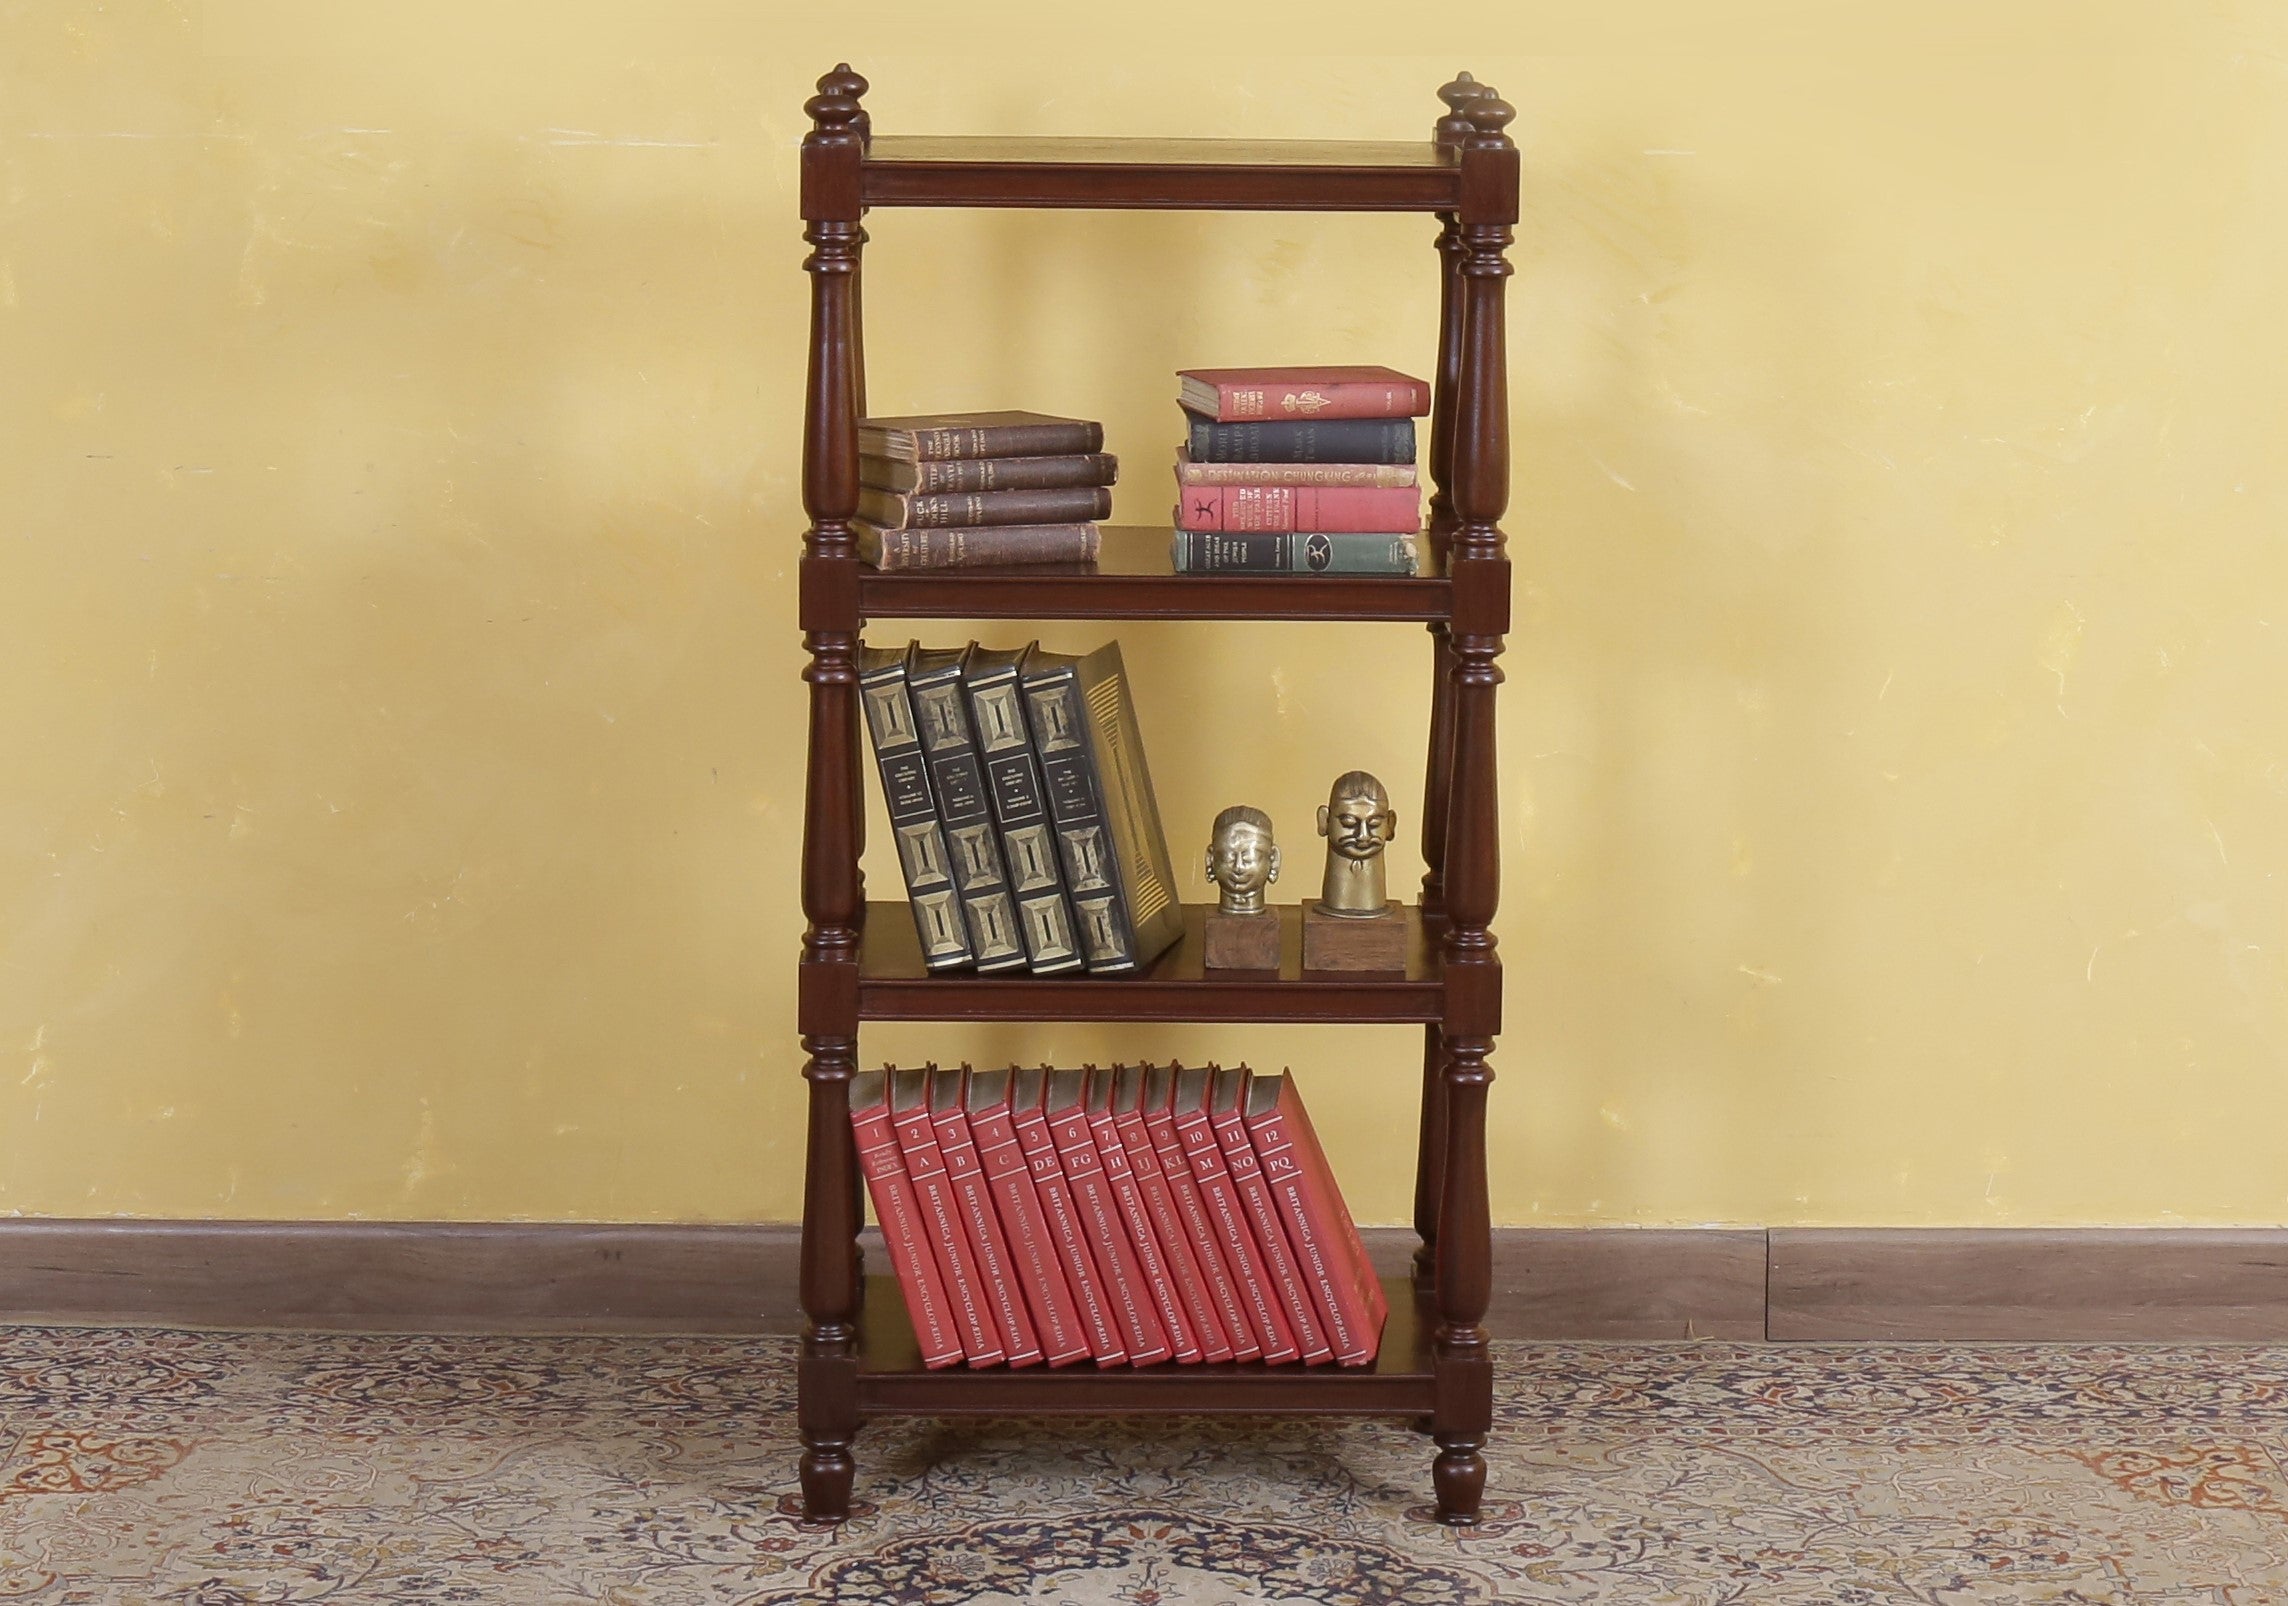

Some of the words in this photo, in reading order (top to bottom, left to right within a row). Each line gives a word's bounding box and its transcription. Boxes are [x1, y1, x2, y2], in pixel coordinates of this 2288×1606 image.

[1283, 469, 1352, 482] CHUNGKING
[911, 1128, 920, 1139] 2
[948, 1128, 957, 1139] 3
[991, 1127, 1000, 1138] 4
[1030, 1131, 1039, 1142] 5
[1068, 1127, 1077, 1138] 6
[1101, 1130, 1110, 1141] 7
[1129, 1132, 1138, 1142] 8
[1161, 1130, 1169, 1140] 9
[1190, 1131, 1203, 1143] 10
[1265, 1130, 1280, 1142] 12
[920, 1157, 930, 1168] A
[956, 1156, 966, 1167] B
[998, 1154, 1009, 1165] C
[1034, 1156, 1055, 1171] DE
[1071, 1154, 1091, 1169] FG
[1110, 1156, 1121, 1169] H
[1200, 1158, 1215, 1170] M
[1232, 1156, 1255, 1172] NO
[1270, 1156, 1294, 1172] PQ
[888, 1184, 912, 1241] BRITANNICA
[903, 1240, 922, 1276] JUNIOR
[927, 1184, 951, 1241] BRITANNICA
[943, 1240, 963, 1276] JUNIOR
[964, 1184, 988, 1241] BRITANNICA
[980, 1240, 1000, 1276] JUNIOR
[1007, 1182, 1032, 1240] BRITANNICA
[1024, 1239, 1043, 1275] JUNIOR
[1048, 1186, 1073, 1242] BRITANNICA
[1066, 1241, 1086, 1278] JUNIOR
[1086, 1183, 1110, 1240] BRITANNICA
[1102, 1239, 1122, 1275] JUNIOR
[1120, 1185, 1146, 1241] BRITANNICA
[1139, 1240, 1162, 1276] JUNIOR
[1149, 1185, 1174, 1241] BRITANNICA
[1168, 1240, 1187, 1276] JUNIOR
[1179, 1184, 1206, 1240] BRITANNICA
[1200, 1239, 1217, 1275] JUNIOR
[1212, 1186, 1238, 1242] BRITANNICA
[1230, 1242, 1251, 1276] JUNIOR
[1247, 1185, 1273, 1241] BRITANNICA
[1267, 1240, 1288, 1276] JUNIOR
[1286, 1185, 1311, 1242] BRITANNICA
[1304, 1241, 1326, 1277] JUNIOR
